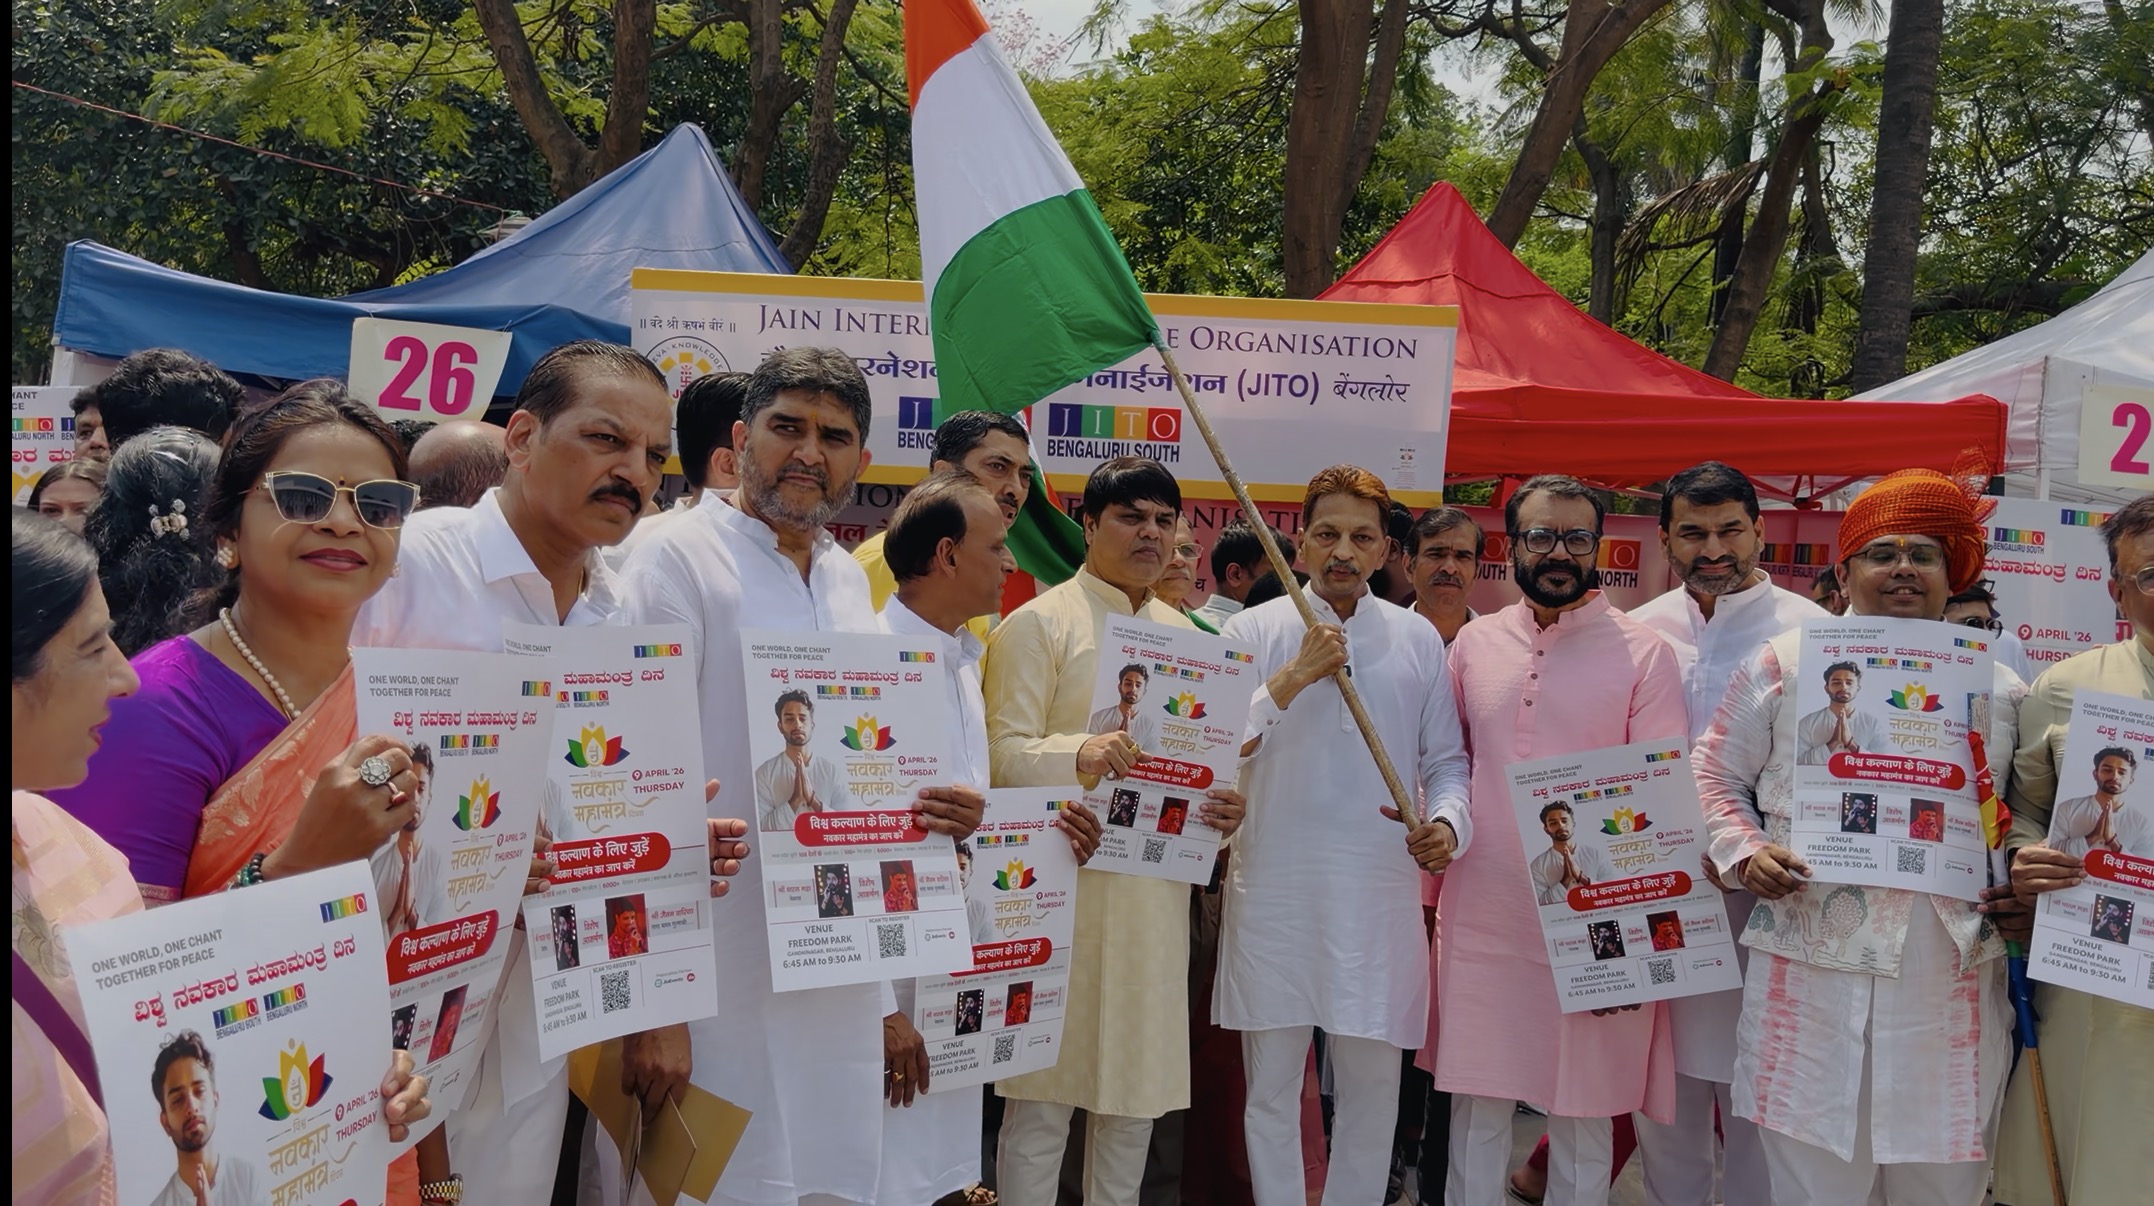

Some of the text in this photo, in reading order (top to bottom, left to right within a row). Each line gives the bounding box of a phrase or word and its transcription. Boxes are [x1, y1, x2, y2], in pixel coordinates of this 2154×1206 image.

[758, 305, 821, 335] JAIN
[1190, 326, 1417, 358] ORGANISATION
[378, 335, 478, 415] 26
[1237, 368, 1319, 405] (JITO)
[1333, 372, 1410, 401] बेंगलोर
[1061, 407, 1177, 439] JITO
[1047, 440, 1130, 460] BENGALURU
[1133, 445, 1180, 463] SOUTH
[1999, 529, 2044, 546] JITO
[1993, 543, 2045, 554] BENGALURU SOUTH
[2075, 566, 2102, 581] ದಿನ
[1111, 631, 1139, 642] TOGETHER
[2036, 629, 2071, 641] APRIL
[752, 652, 792, 660] TOGETHER
[767, 645, 793, 653] WORLD,
[808, 646, 831, 654] CHANT
[368, 675, 459, 685] ONE WORLD, ONE CHANT
[369, 687, 452, 696] TOGETHER FOR PEACE
[2082, 709, 2120, 722] TOGETHER
[2120, 716, 2136, 724] FOR
[2083, 702, 2144, 719] ONE WORLD, ONE
[645, 769, 671, 777] APRIL
[899, 768, 938, 776] THURSDAY
[1562, 764, 1583, 772] CHANT
[1516, 771, 1577, 787] TOGETHER FOR PEACE
[634, 781, 685, 794] THURSDAY
[1109, 838, 1127, 846] PARK
[1658, 837, 1695, 847] THURSDAY
[1825, 835, 1854, 843] VENUE
[1117, 851, 1129, 860] AM
[1807, 844, 1871, 854] FREEDOM PARK
[1818, 858, 1878, 870] AM to 9:30 AM
[804, 923, 833, 934] VENUE
[788, 934, 853, 948] FREEDOM PARK
[2072, 937, 2103, 952] VENUE
[91, 929, 223, 973] ONE WORLD, ONE CHANT
[2051, 942, 2121, 966] FREEDOM PARK
[783, 953, 862, 968] 6:45 AM to 9:30 AM
[95, 947, 216, 991] TOGETHER FOR PEACE
[173, 967, 240, 1010] ನವಕಾರ
[332, 932, 356, 959] ದಿನ
[1584, 963, 1609, 973] VENUE
[2041, 956, 2126, 984] 6:45 AM to 9:30 AM
[1571, 970, 1627, 983] FREEDOM PARK
[1567, 988, 1584, 997] 6:45
[1584, 987, 1597, 996] AM
[1597, 986, 1606, 994] to
[1606, 984, 1622, 993] 9:30
[1622, 982, 1636, 991] AM
[942, 1039, 964, 1049] VENUE
[959, 1047, 976, 1056] PARK
[967, 1061, 979, 1071] AM
[345, 1097, 368, 1114] APRIL
[335, 1110, 379, 1142] THURSDAY
